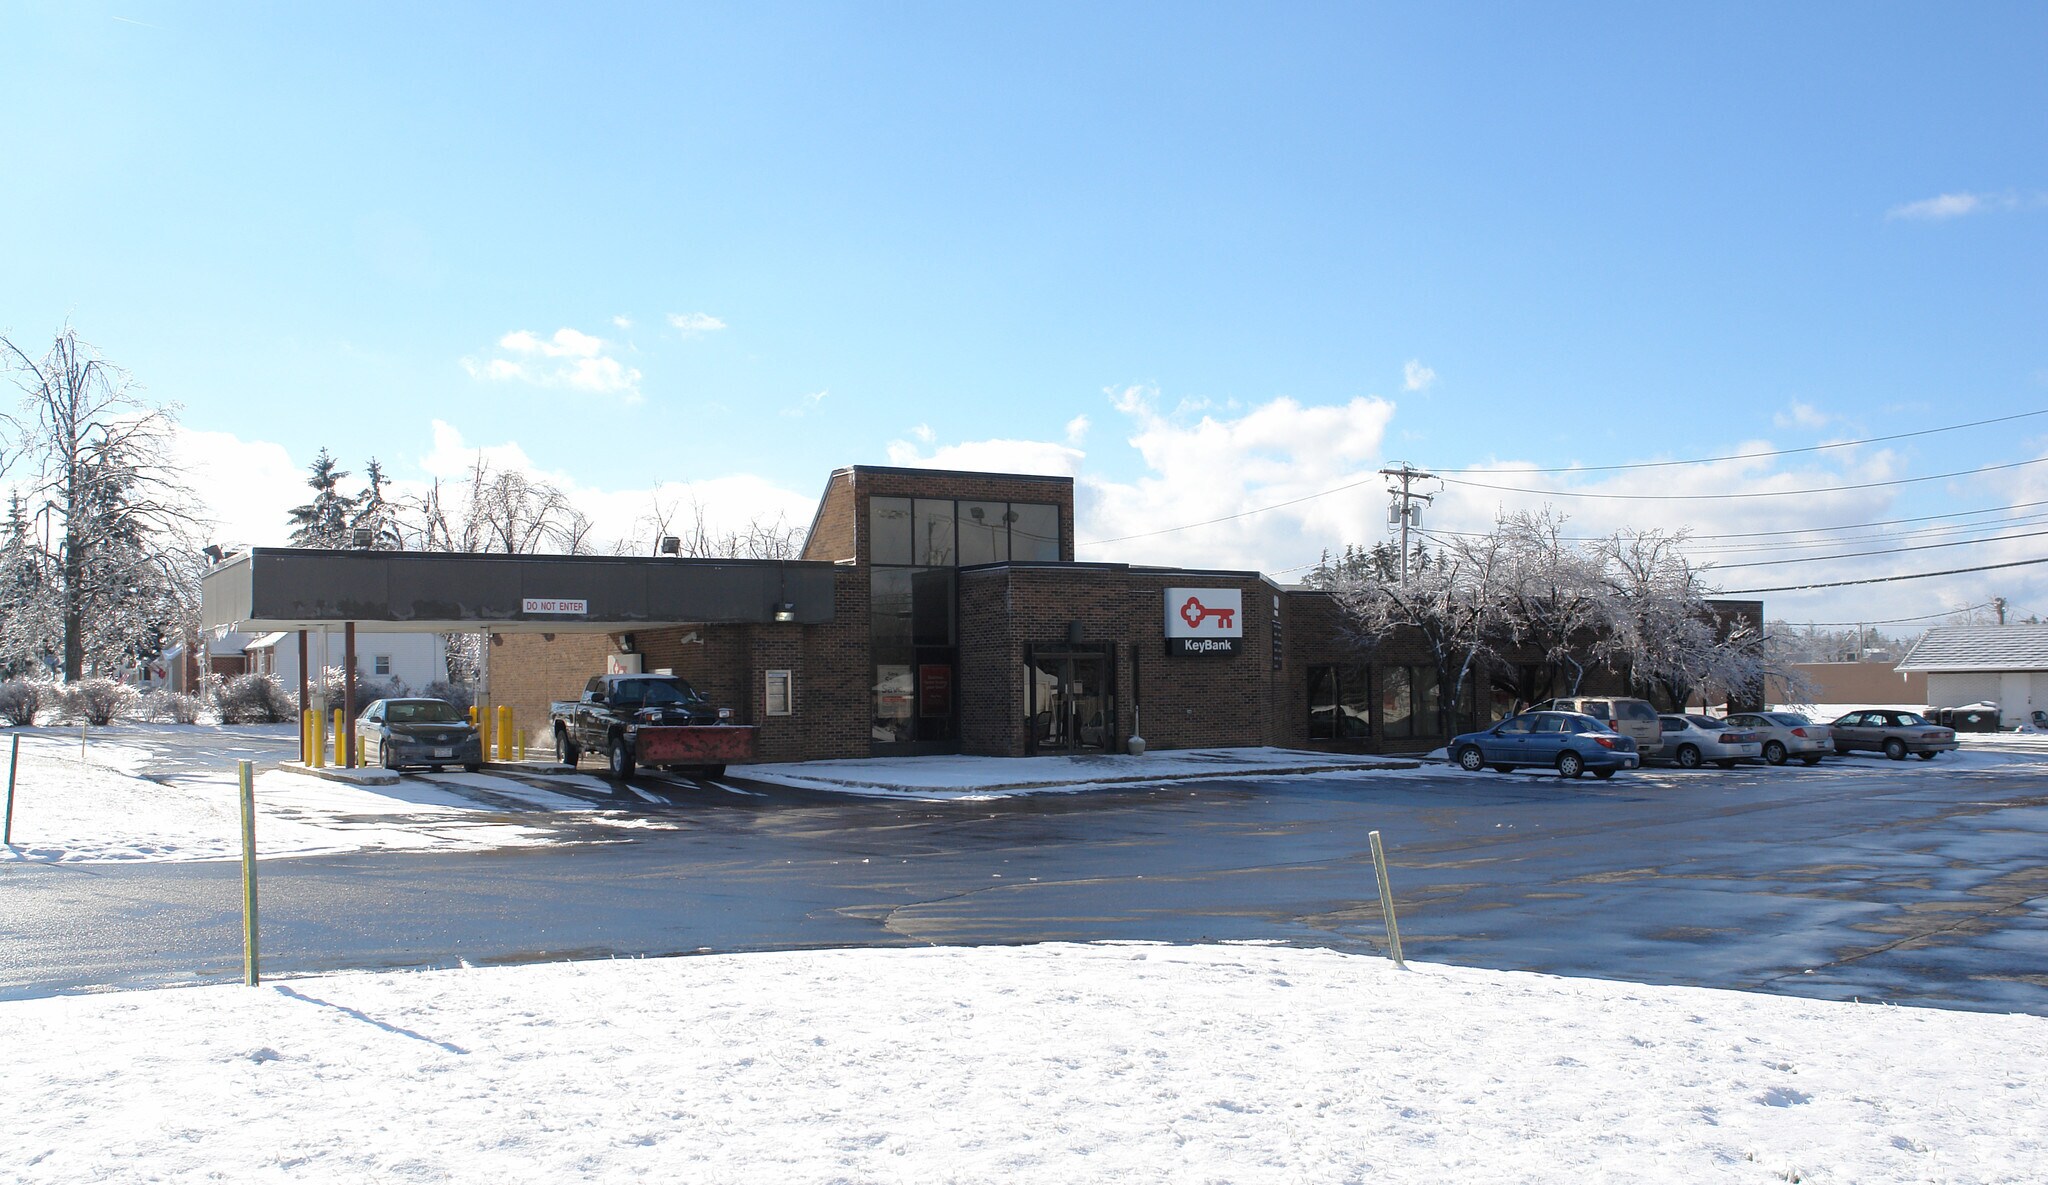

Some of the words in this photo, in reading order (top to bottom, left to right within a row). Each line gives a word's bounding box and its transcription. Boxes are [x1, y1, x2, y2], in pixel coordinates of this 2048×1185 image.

[526, 601, 538, 611] DO
[541, 601, 556, 611] NOT
[559, 602, 584, 611] ENTER
[1184, 639, 1232, 653] KeyBank
